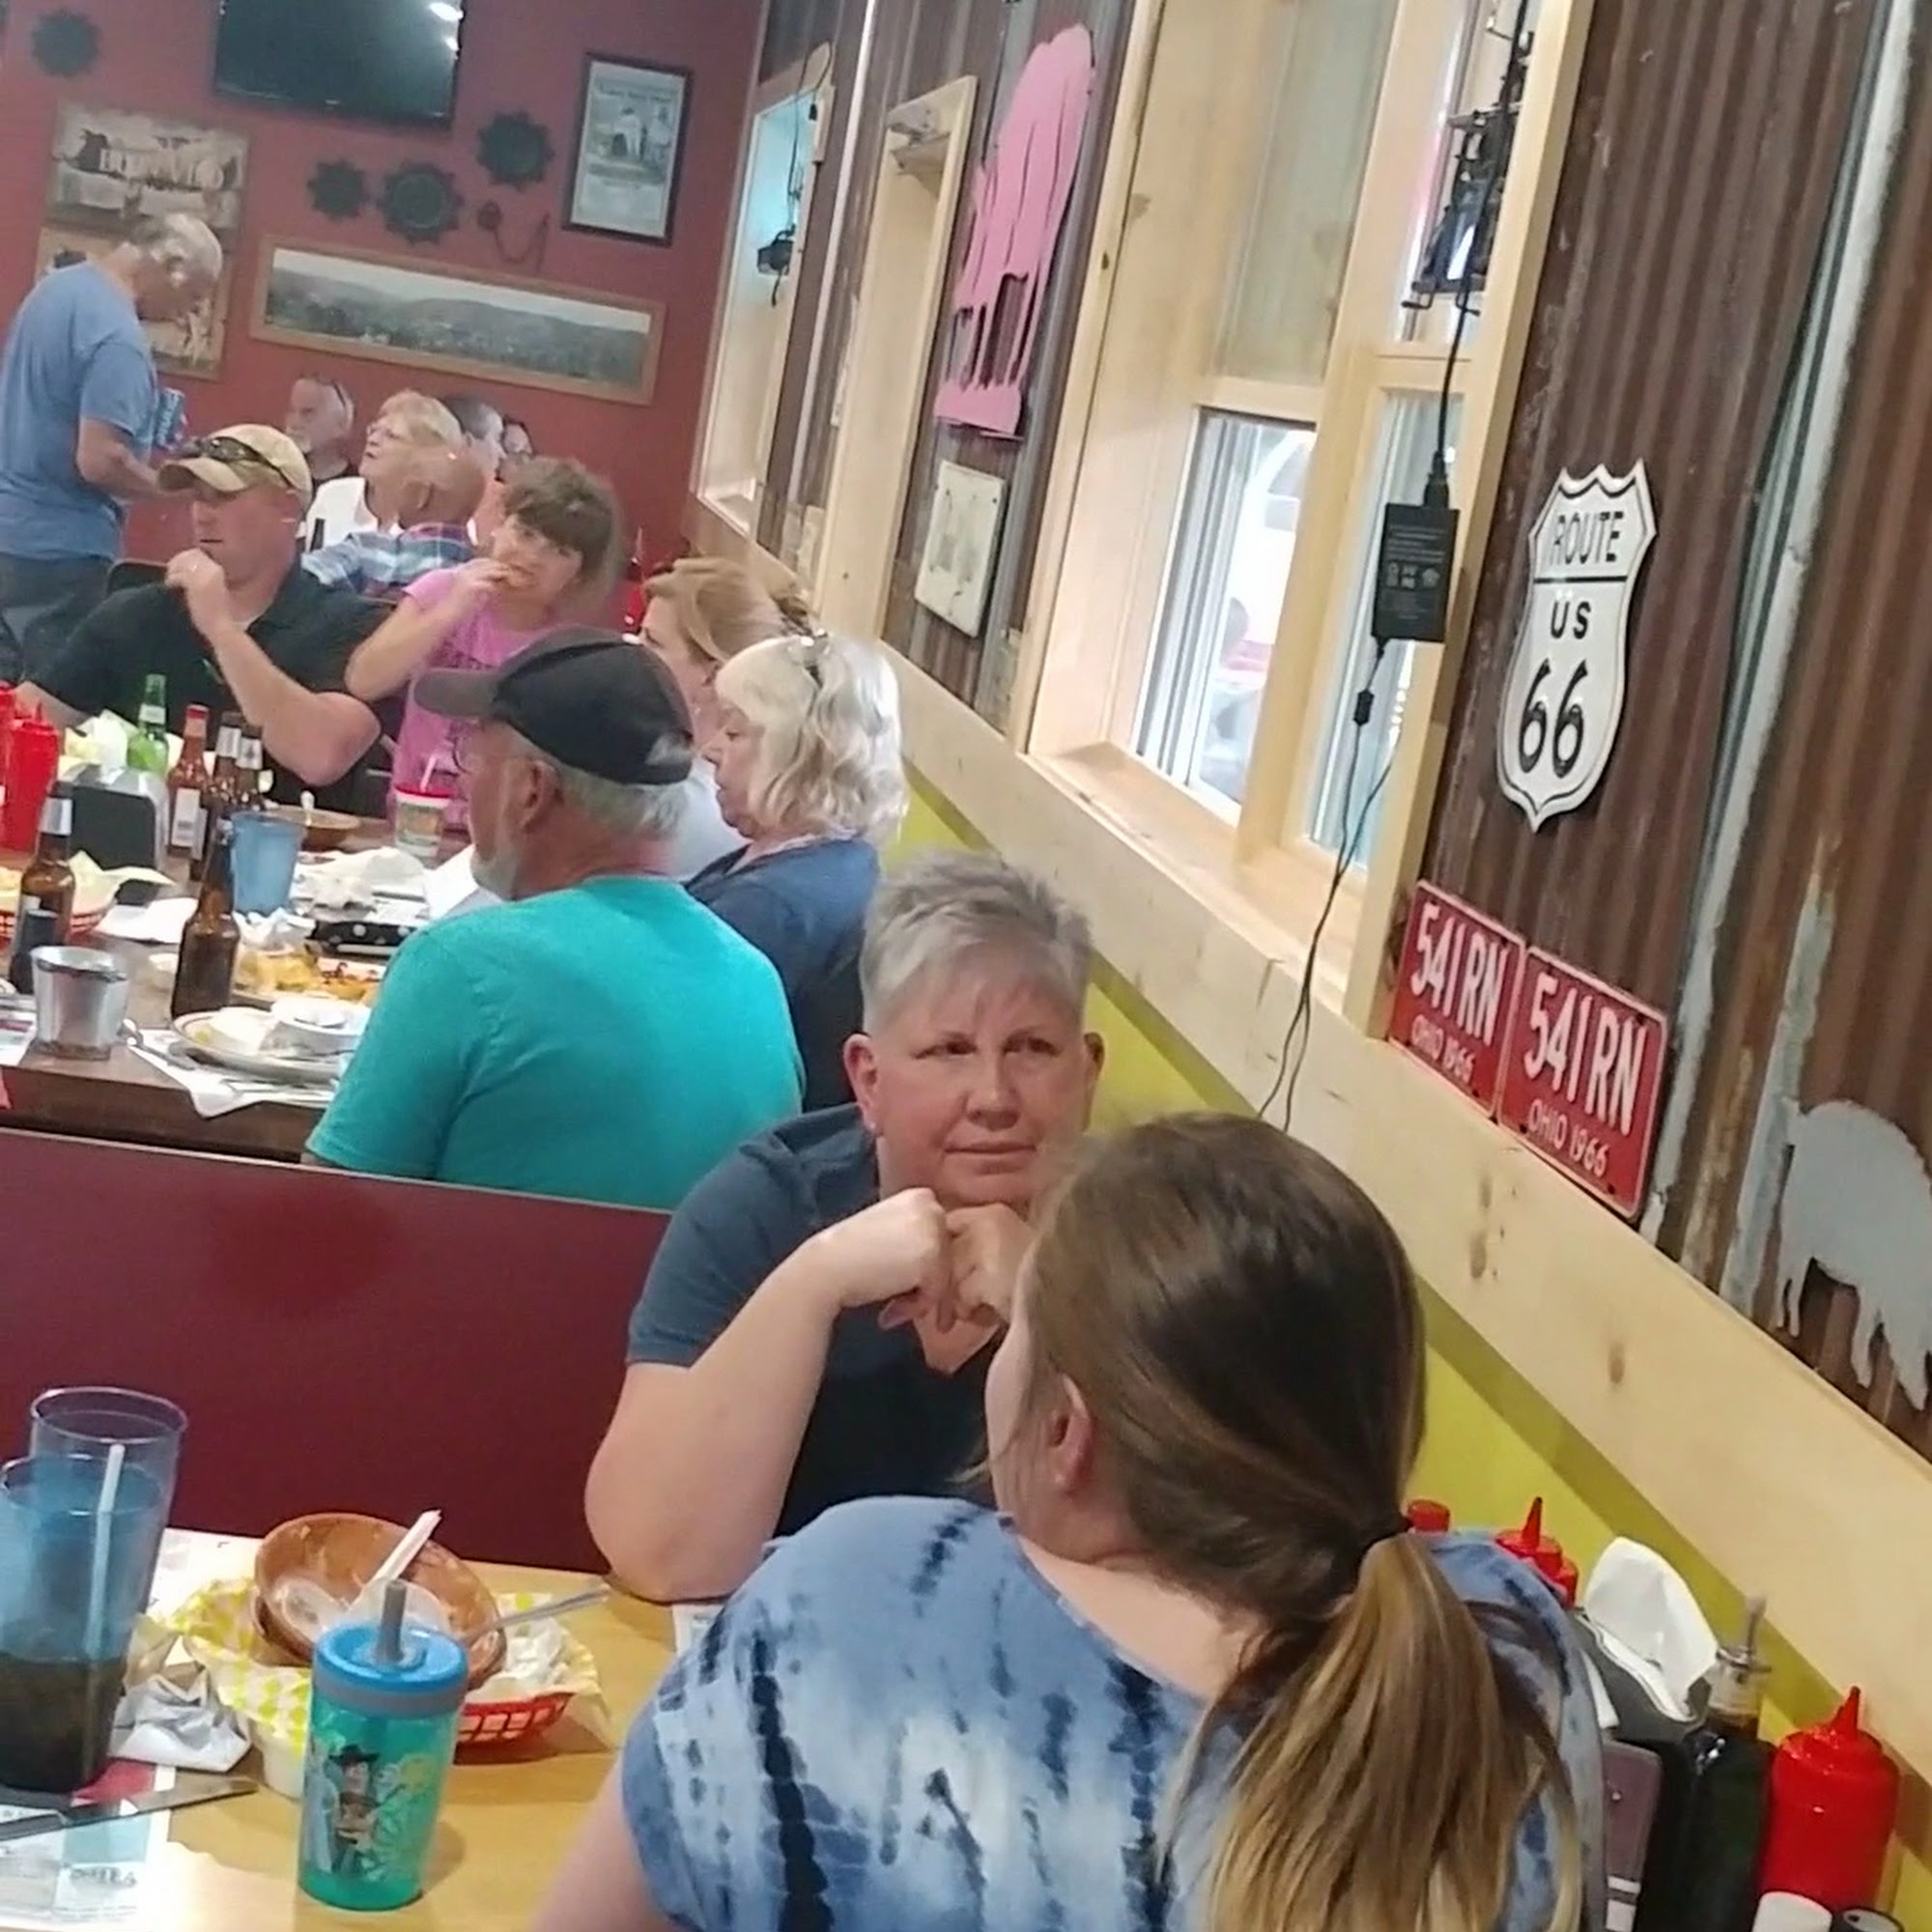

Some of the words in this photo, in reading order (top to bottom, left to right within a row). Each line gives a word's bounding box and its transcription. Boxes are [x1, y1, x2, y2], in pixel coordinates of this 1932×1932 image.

[1548, 510, 1625, 566] ROUTE
[1549, 600, 1591, 639] US
[1518, 658, 1588, 779] 66
[1527, 1098, 1568, 1150] OHIO
[1569, 1128, 1610, 1178] 1966
